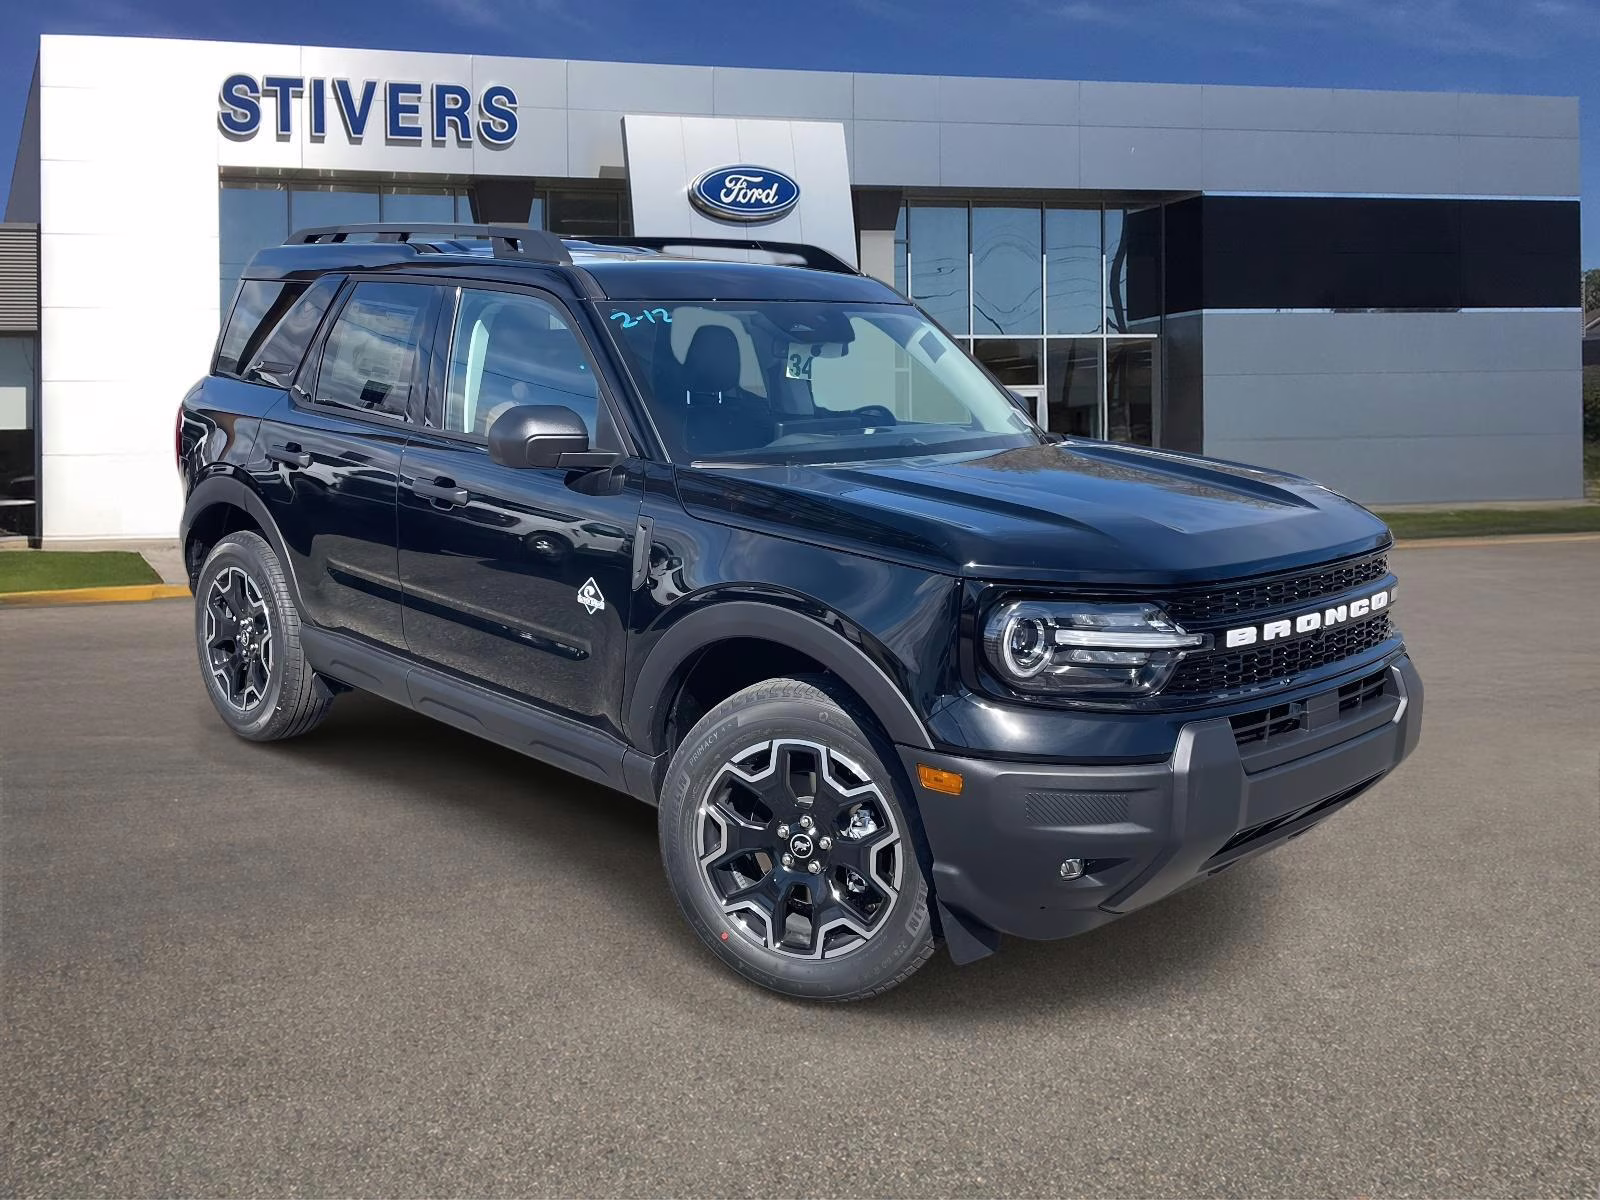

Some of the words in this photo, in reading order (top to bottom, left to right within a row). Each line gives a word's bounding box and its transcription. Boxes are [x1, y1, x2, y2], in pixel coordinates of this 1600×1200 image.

[217, 73, 519, 147] STIVERS
[720, 174, 779, 204] Ford
[789, 353, 812, 380] 34
[1226, 591, 1388, 648] BRONCO
[689, 731, 719, 766] PRIMACY
